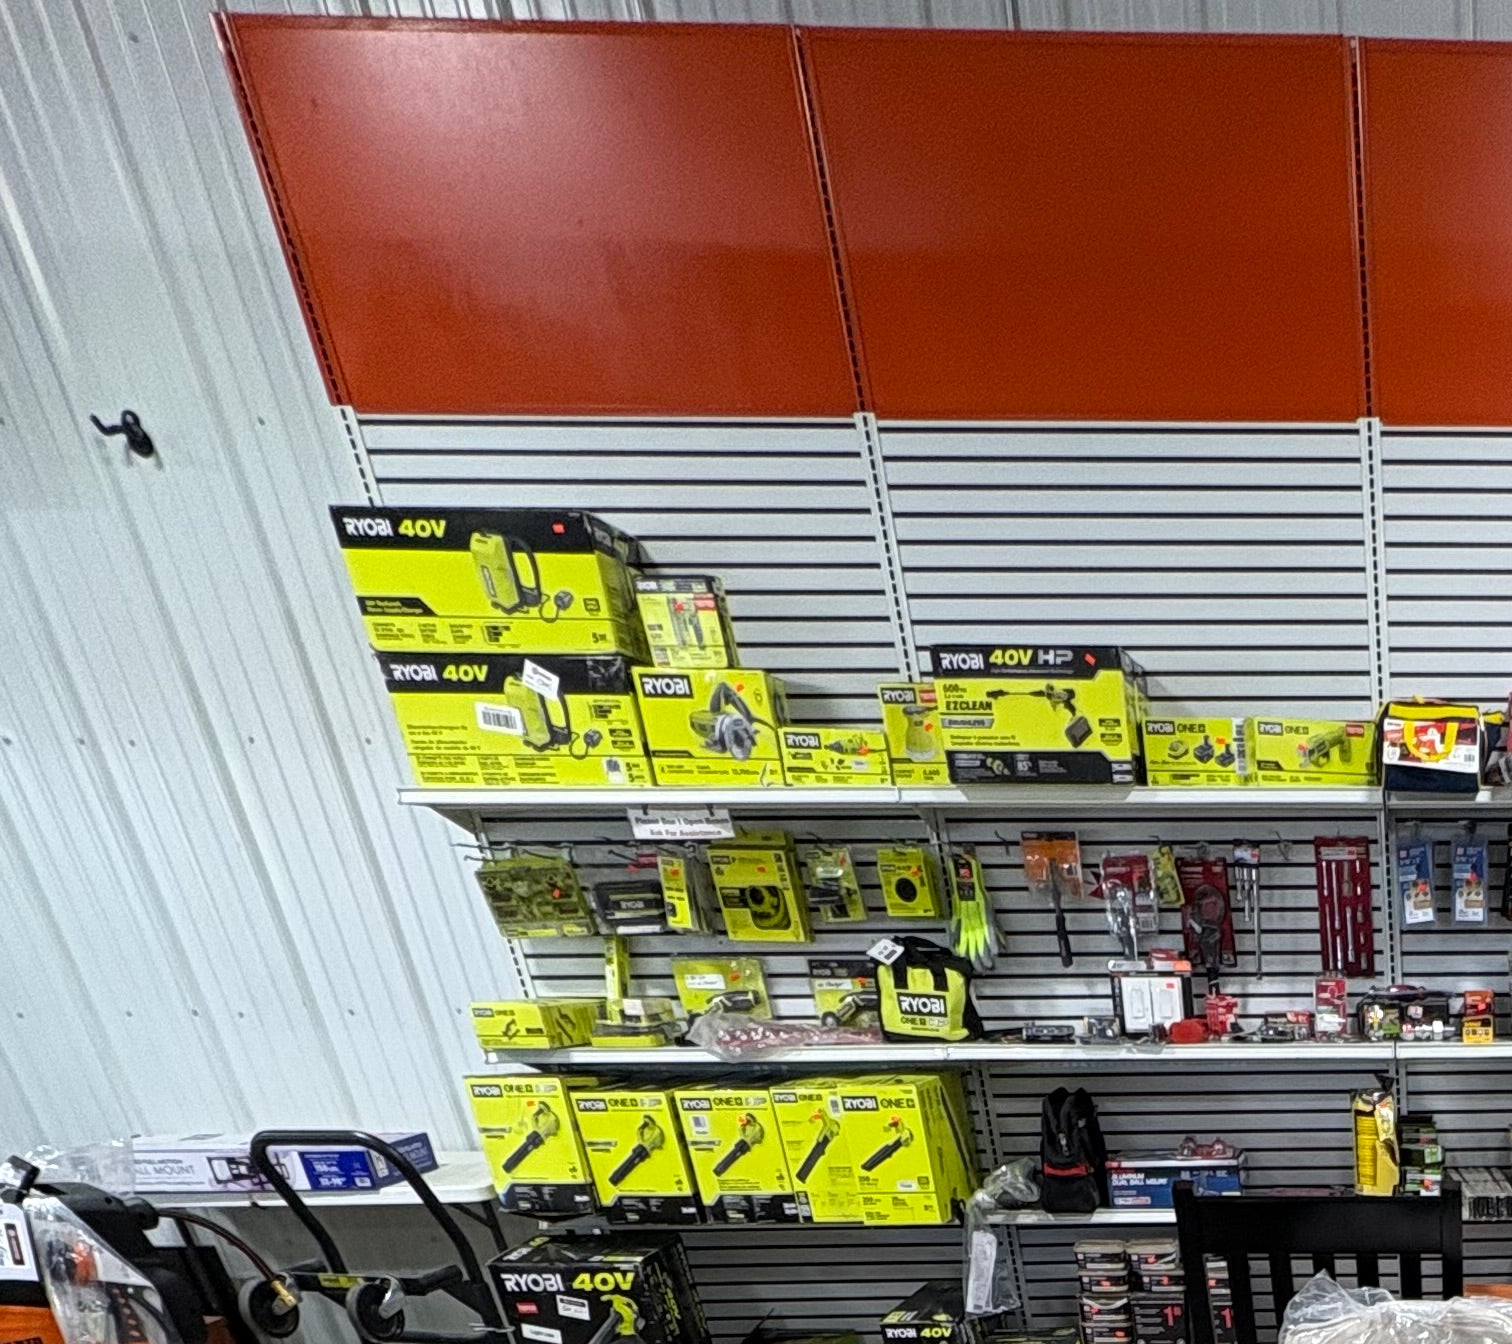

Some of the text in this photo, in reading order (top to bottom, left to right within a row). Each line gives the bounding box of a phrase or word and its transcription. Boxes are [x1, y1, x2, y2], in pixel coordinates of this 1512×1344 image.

[343, 517, 446, 538] RYOBI 40V
[939, 649, 1074, 670] RYOBI 40V HP
[390, 664, 488, 682] RYOBI 40V
[642, 677, 689, 696] RYOBI
[882, 690, 915, 703] RYOBI
[945, 701, 993, 710] EZCLEAN
[786, 735, 819, 748] RYOBI
[900, 997, 945, 1014] RYOBI
[472, 1087, 501, 1097] RYOBI
[774, 1094, 796, 1102] RYOBI
[577, 1101, 607, 1111] RYOBI
[682, 1100, 711, 1110] RYOBI
[844, 1098, 877, 1110] RYOBI
[501, 1272, 635, 1292] RYOBI 40V
[886, 1328, 951, 1339] RYOBI 40V
